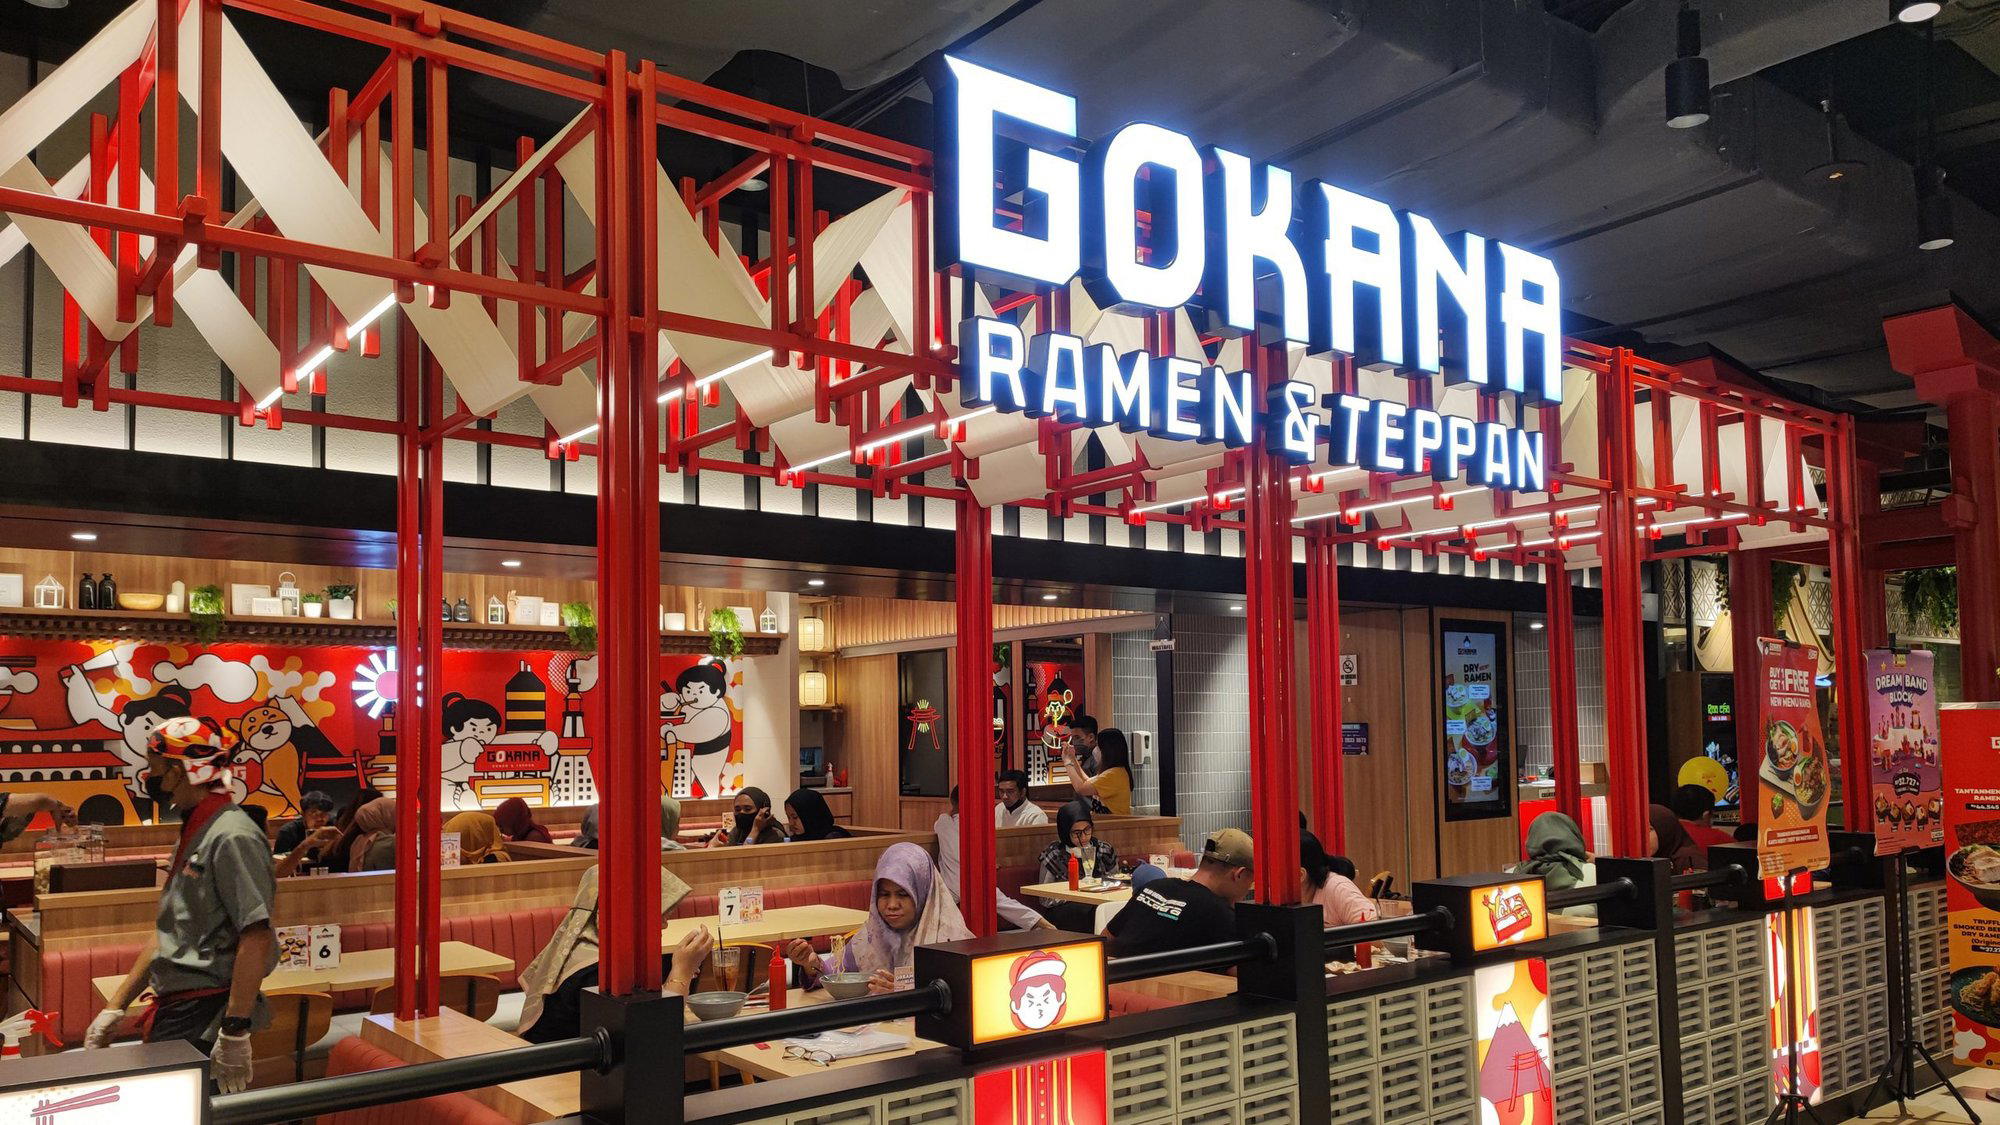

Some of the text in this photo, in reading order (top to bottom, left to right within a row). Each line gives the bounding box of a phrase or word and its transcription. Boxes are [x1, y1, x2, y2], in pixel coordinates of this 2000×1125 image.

[943, 53, 1563, 405] GOKANA
[977, 317, 1544, 492] RAMEN & TEPPAN
[1464, 663, 1479, 673] DRY
[1769, 666, 1780, 678] BUY
[1464, 672, 1492, 683] RAMEN
[1785, 668, 1810, 693] FREE
[1875, 674, 1928, 691] DREAM BAND
[1769, 679, 1780, 690] GET
[1782, 697, 1799, 708] MENU
[1889, 690, 1913, 703] BLOCK
[487, 750, 541, 763] GOKANA
[726, 904, 734, 916] 7
[1953, 923, 1986, 931] SMOKED
[319, 945, 331, 959] 6
